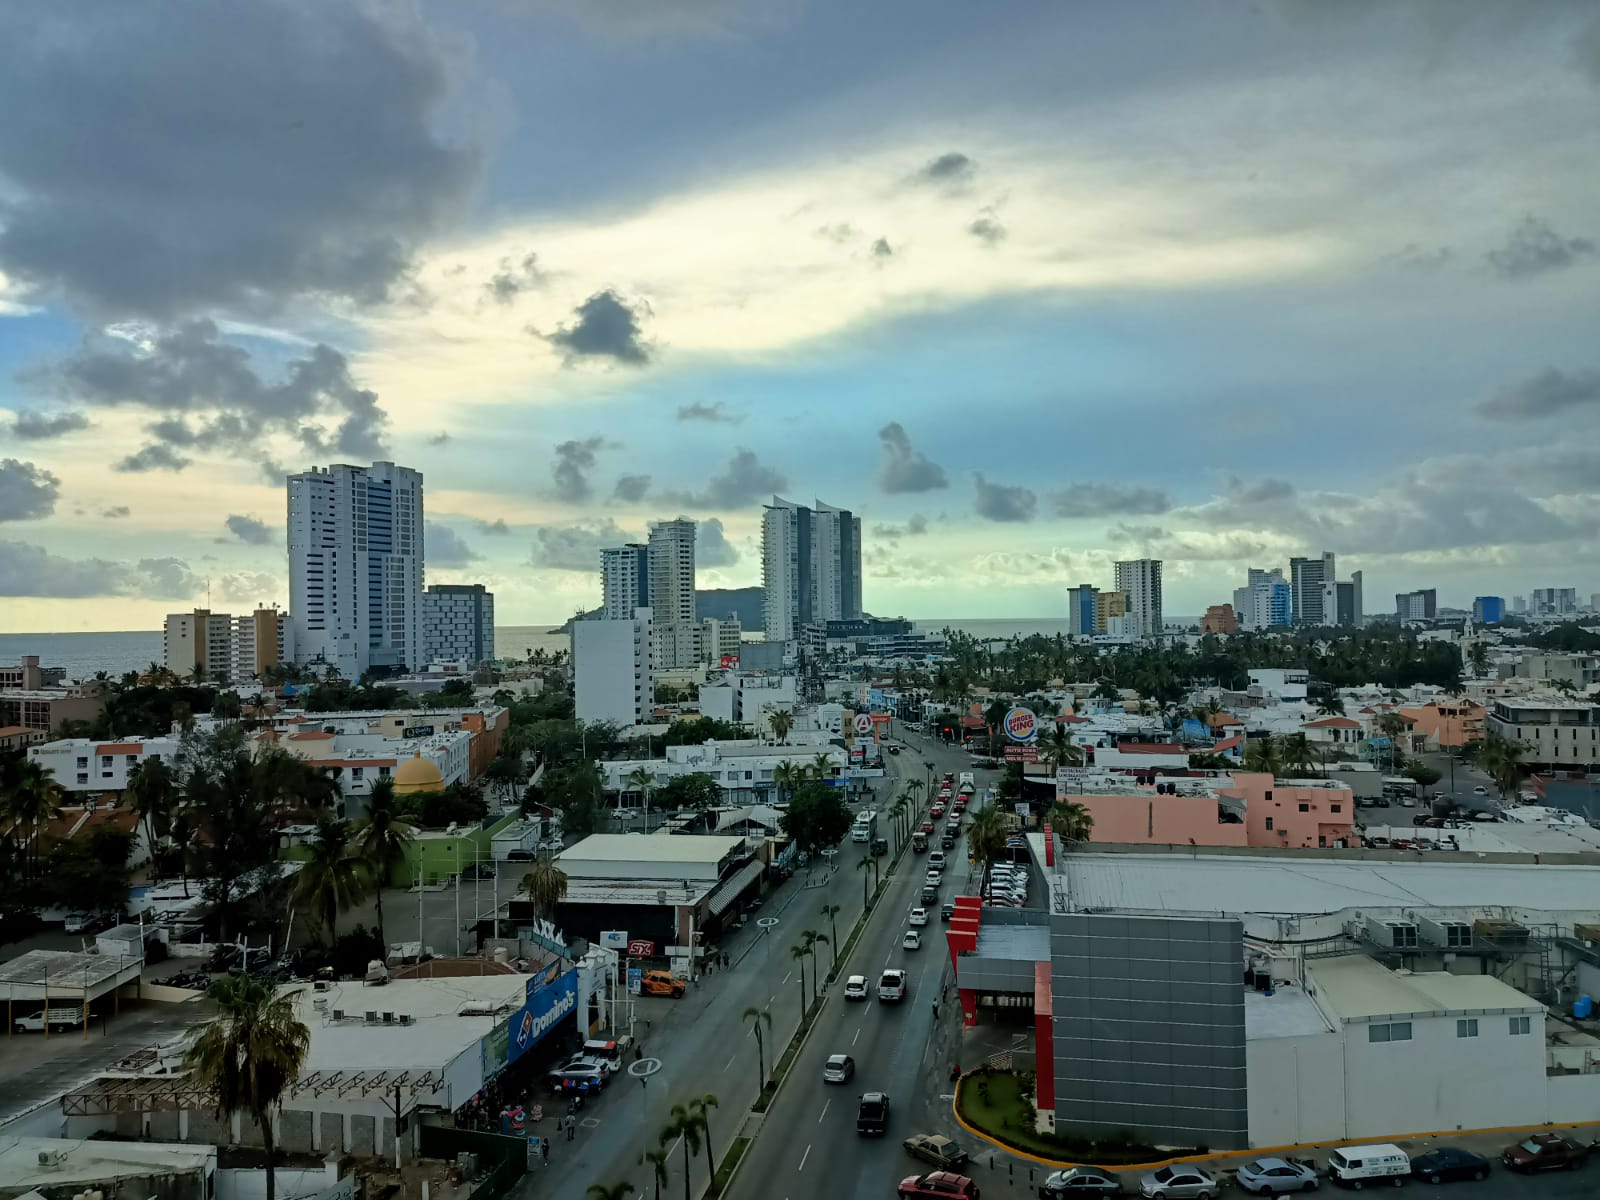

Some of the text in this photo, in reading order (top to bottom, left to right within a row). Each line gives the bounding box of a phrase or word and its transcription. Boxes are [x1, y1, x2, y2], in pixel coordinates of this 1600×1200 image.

[1009, 715, 1033, 725] BURGER
[1010, 720, 1034, 732] KING
[532, 990, 575, 1037] Domino's
